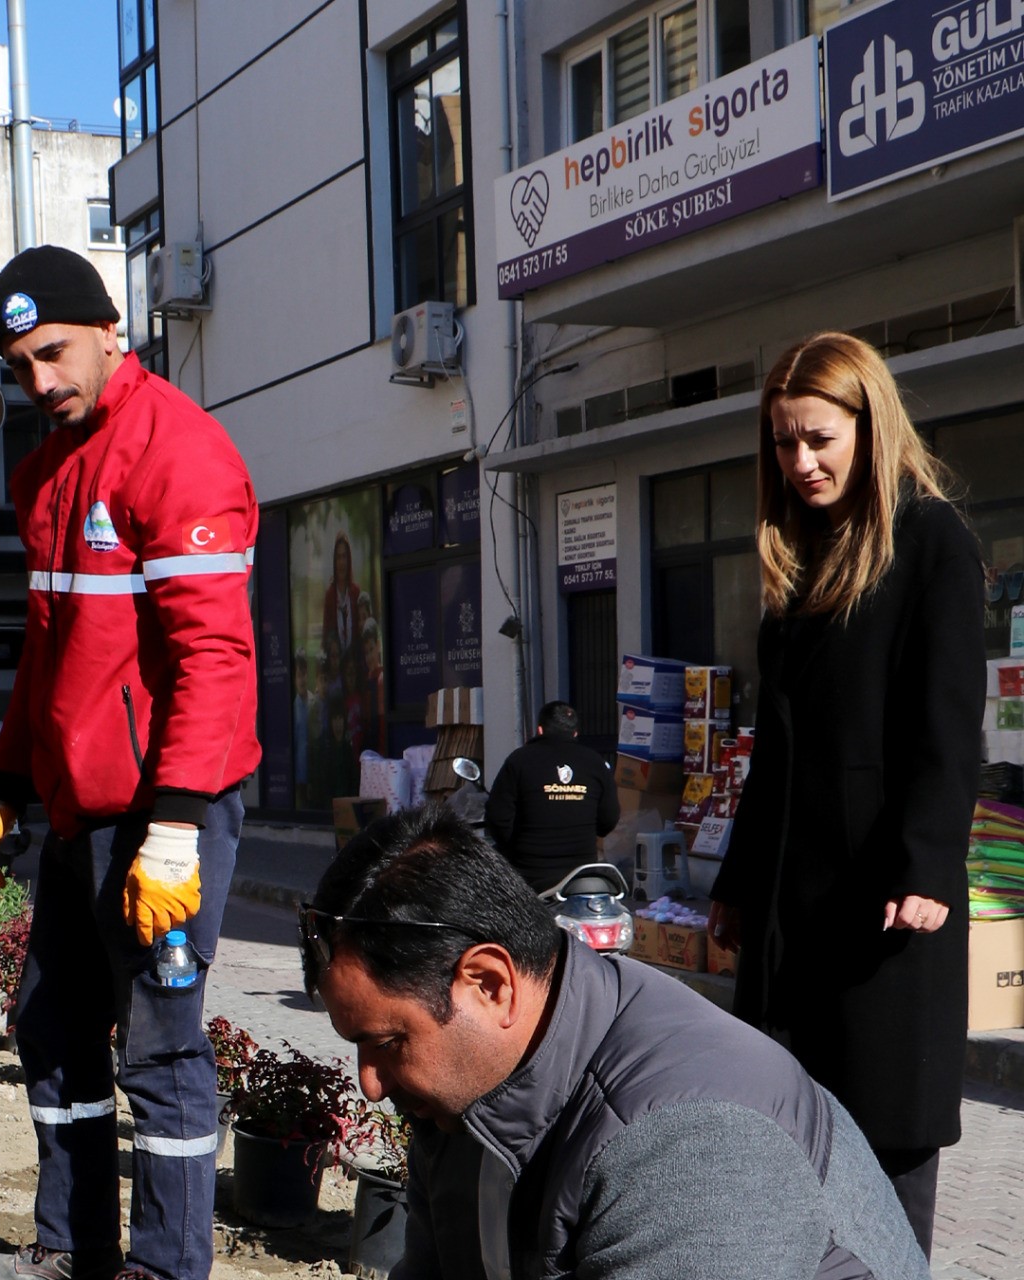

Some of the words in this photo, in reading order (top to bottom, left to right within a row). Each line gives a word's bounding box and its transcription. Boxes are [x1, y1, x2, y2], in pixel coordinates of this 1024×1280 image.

[933, 46, 1006, 93] YÖNETİM
[933, 90, 974, 120] TRAFİK
[564, 114, 674, 190] hepbirlik
[688, 68, 789, 138] sigorta
[589, 186, 634, 218] Birlikte
[638, 166, 680, 200] Daha
[684, 127, 761, 180] Güçlüyüz!
[625, 206, 670, 241] SÖKE
[672, 177, 734, 228] ŞUBESİ
[498, 261, 520, 286] 0541
[522, 254, 540, 278] 573
[541, 249, 553, 270] 77
[555, 243, 568, 265] 55
[563, 574, 580, 585] 0541
[581, 572, 594, 583] 573
[595, 570, 603, 580] 77
[604, 569, 614, 580] 55
[543, 783, 587, 794] SÖNMEZ
